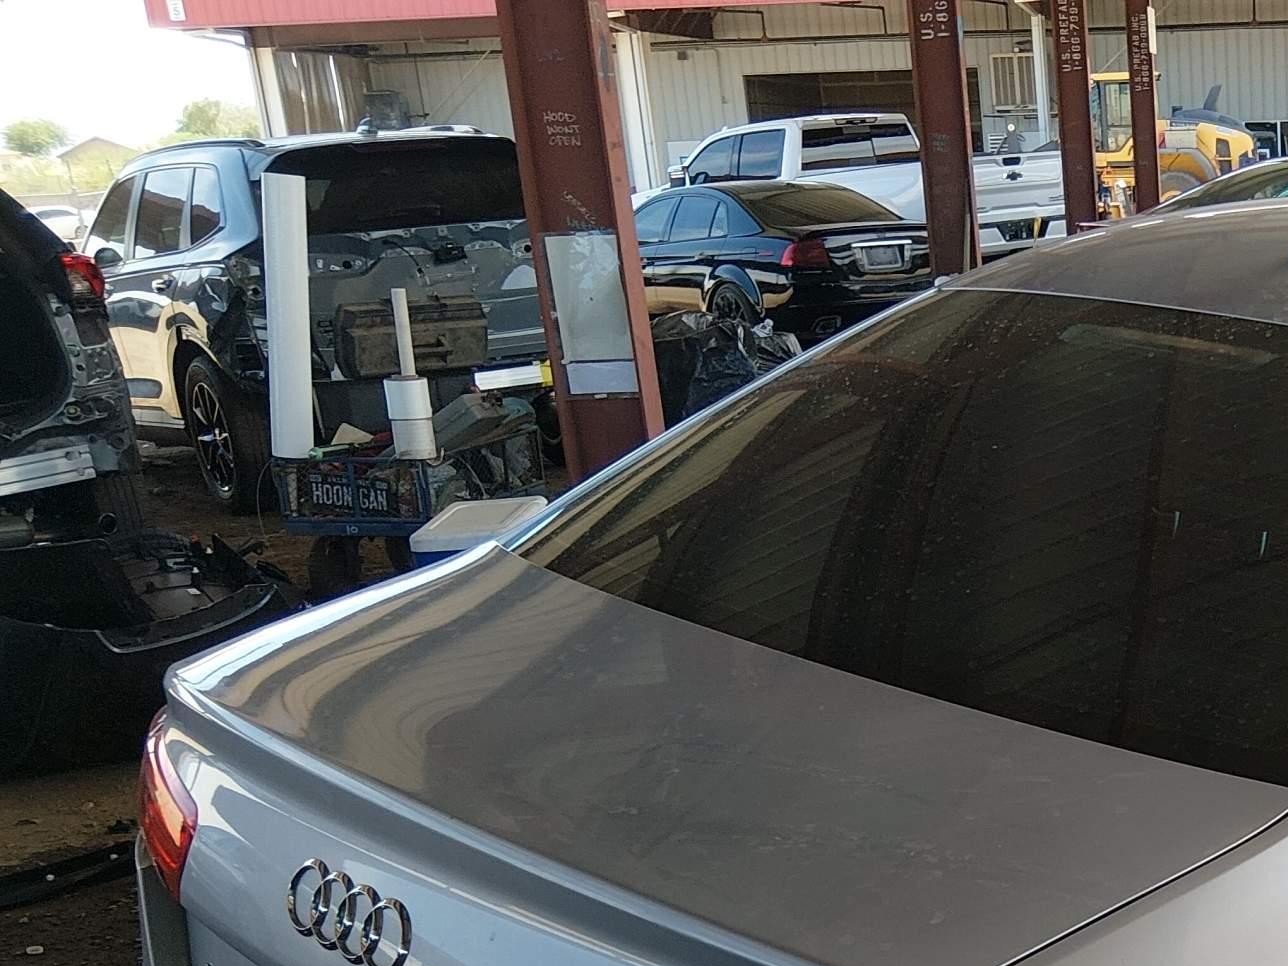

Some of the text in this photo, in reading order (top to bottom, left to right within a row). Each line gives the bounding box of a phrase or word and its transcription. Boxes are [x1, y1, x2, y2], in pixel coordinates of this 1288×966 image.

[920, 7, 935, 40] U.S.
[1061, 49, 1072, 72] U.S.
[311, 482, 388, 511] HOONGAN
